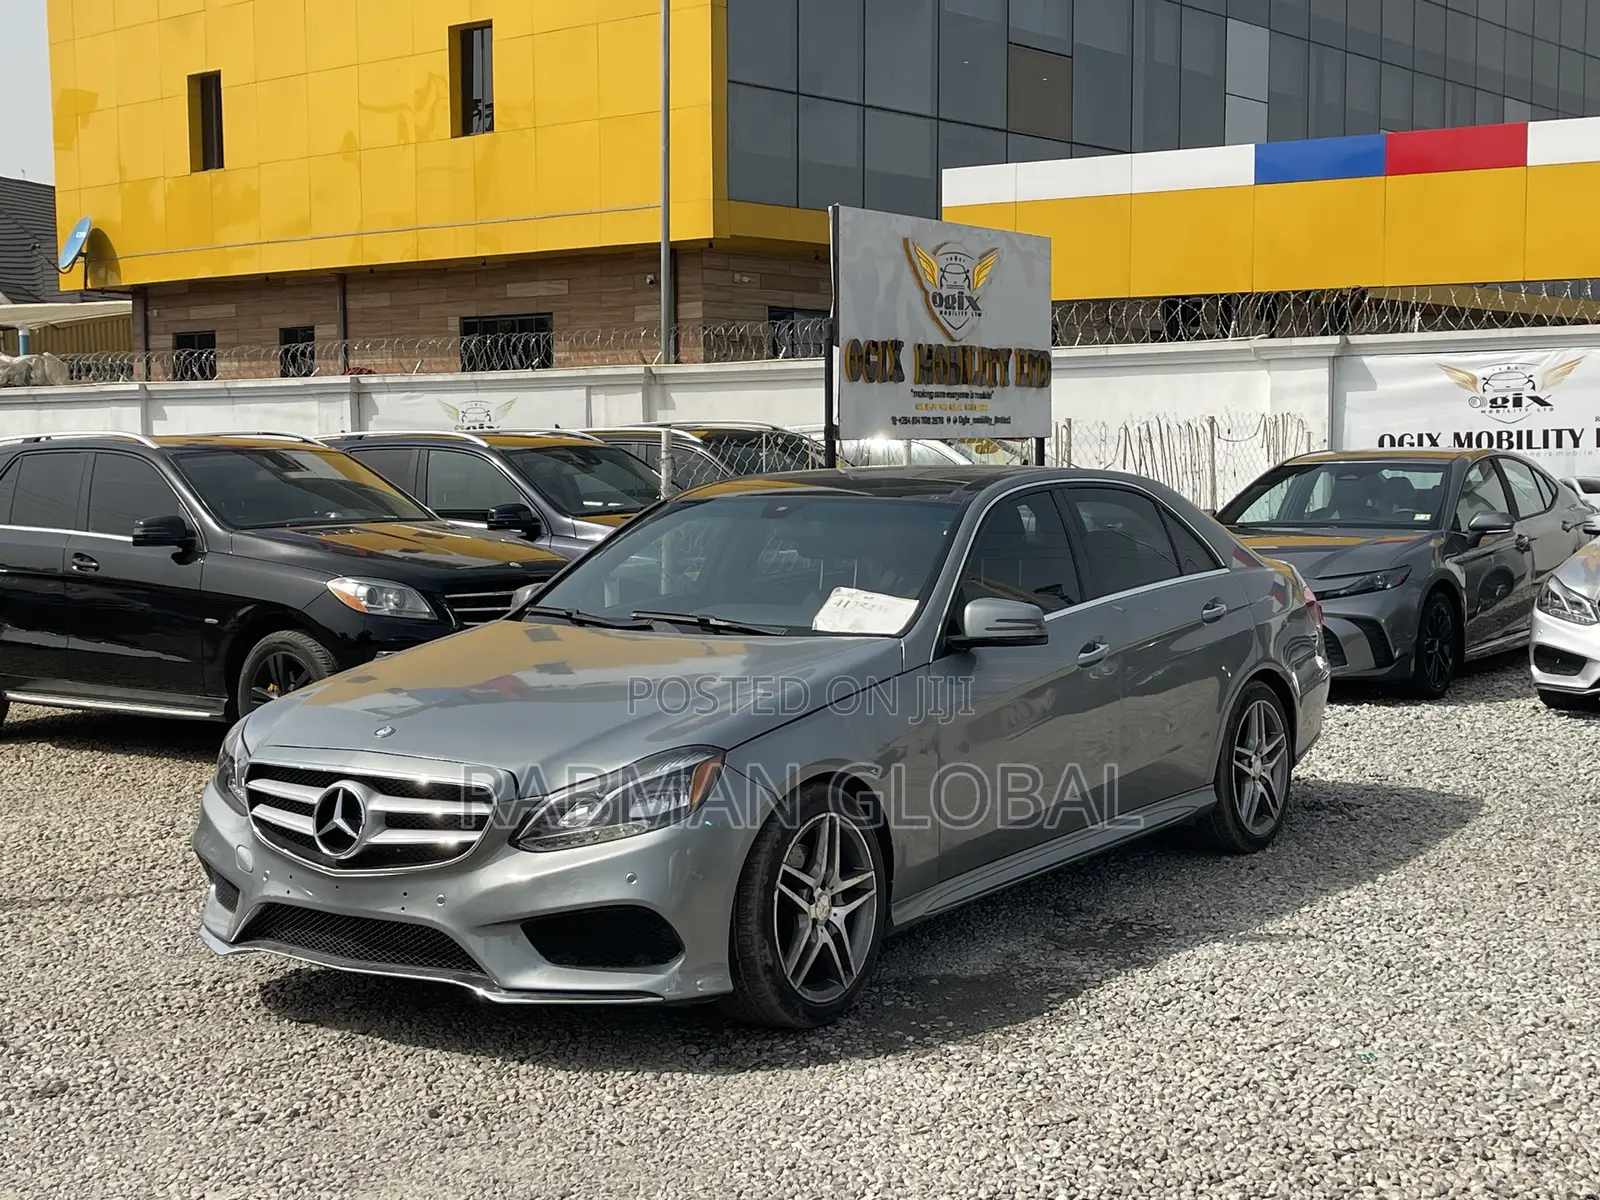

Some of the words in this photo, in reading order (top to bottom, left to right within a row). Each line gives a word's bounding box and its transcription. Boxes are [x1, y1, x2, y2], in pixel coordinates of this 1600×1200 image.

[845, 339, 905, 383] OGIX
[1378, 432, 1442, 448] OGIX
[1453, 428, 1584, 449] MOBILITY
